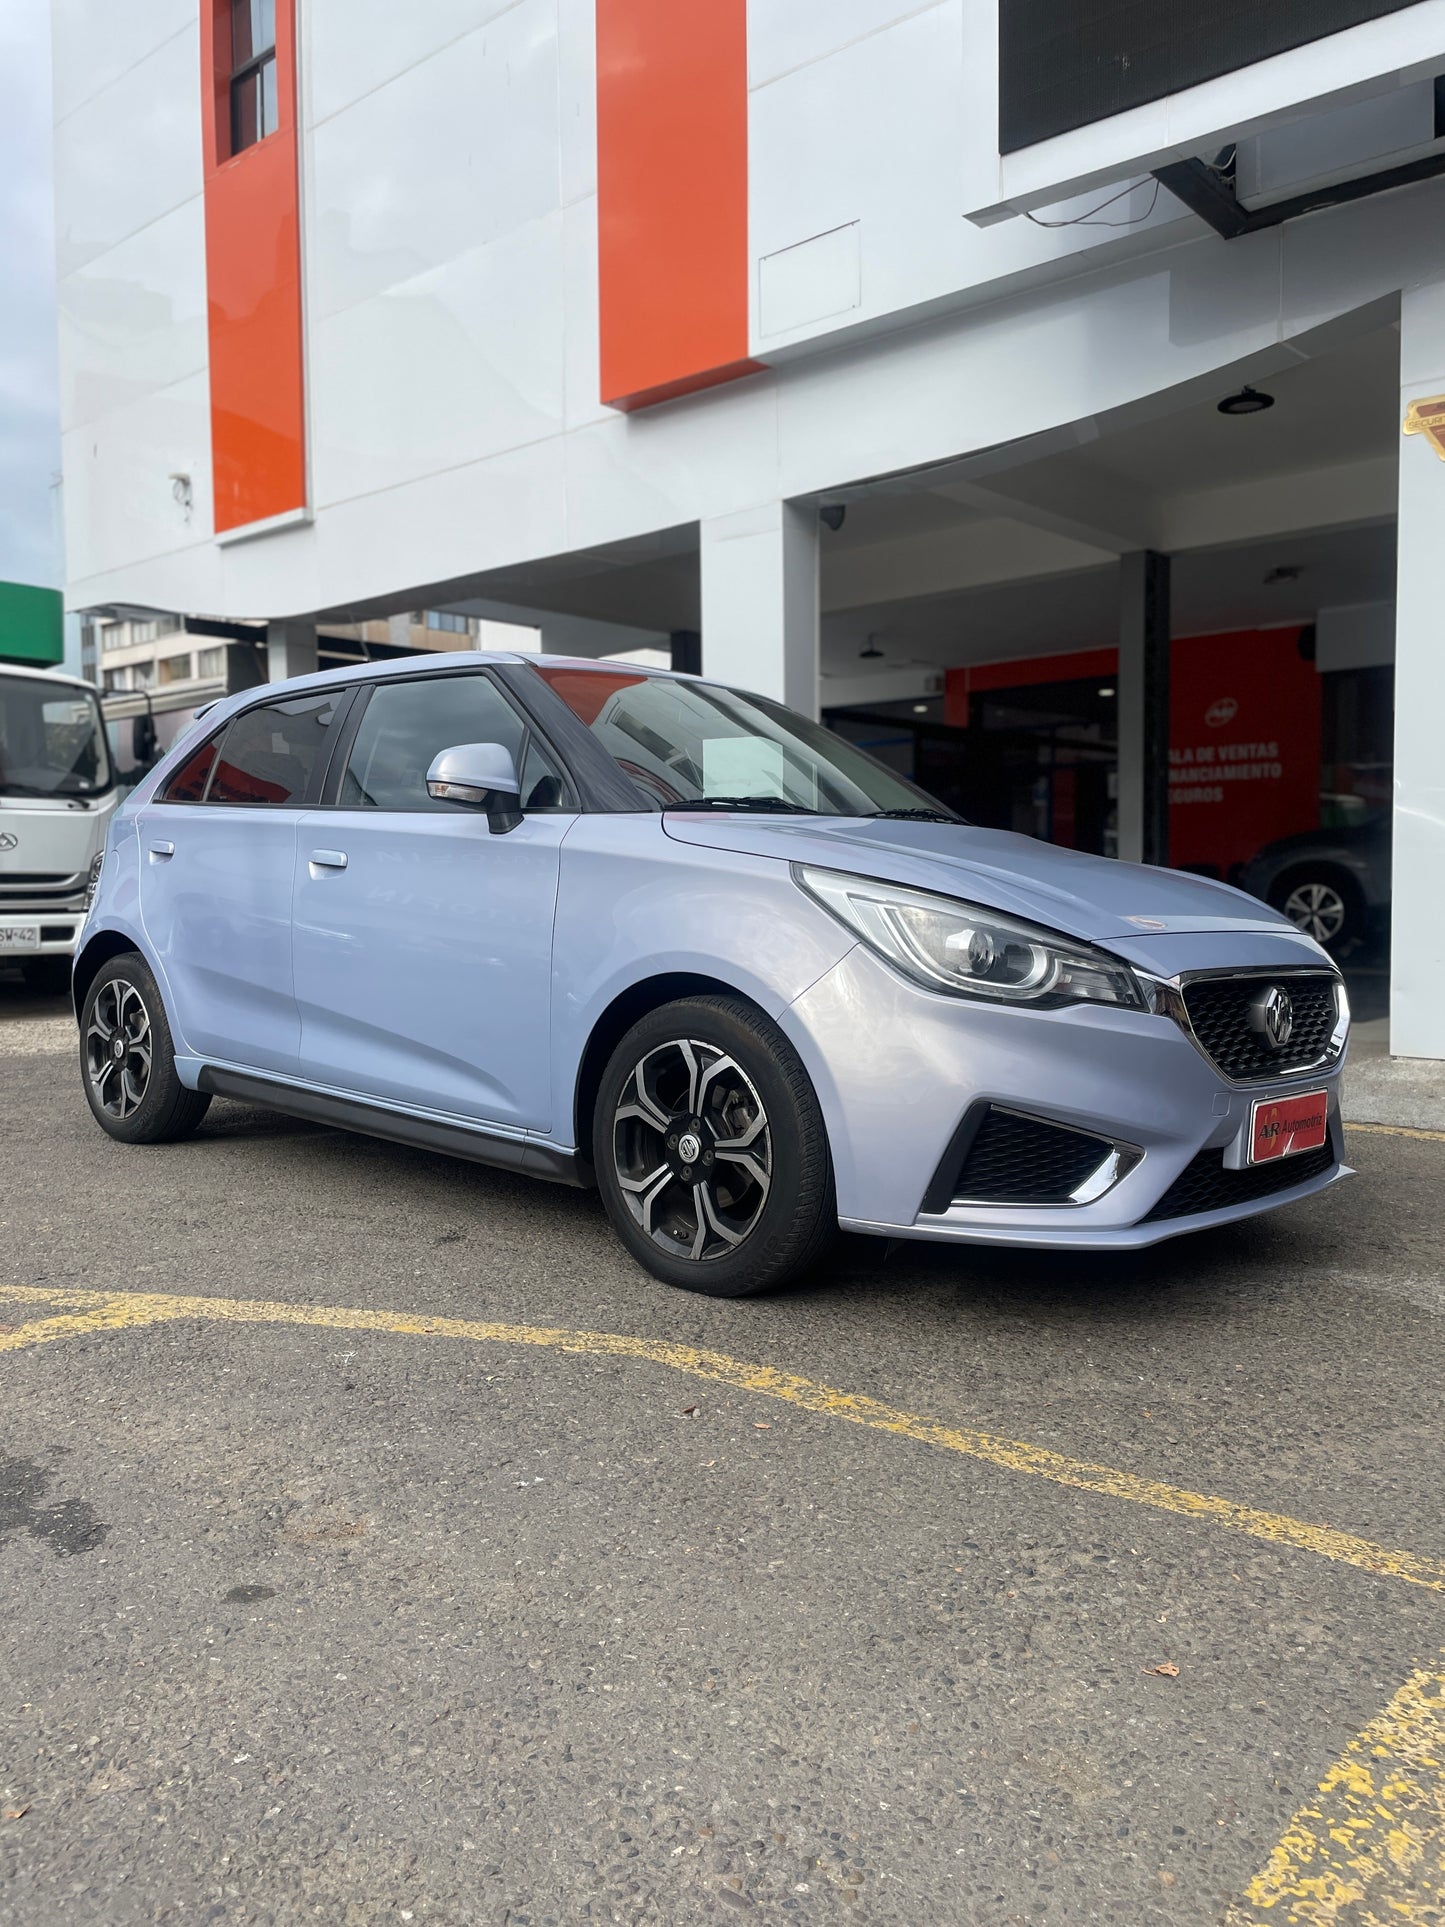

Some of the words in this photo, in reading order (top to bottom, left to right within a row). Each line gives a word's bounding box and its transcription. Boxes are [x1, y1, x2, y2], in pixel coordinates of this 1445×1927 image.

[1408, 416, 1445, 429] SECURI
[1196, 746, 1215, 762] DE
[1218, 742, 1279, 761] VENTAS
